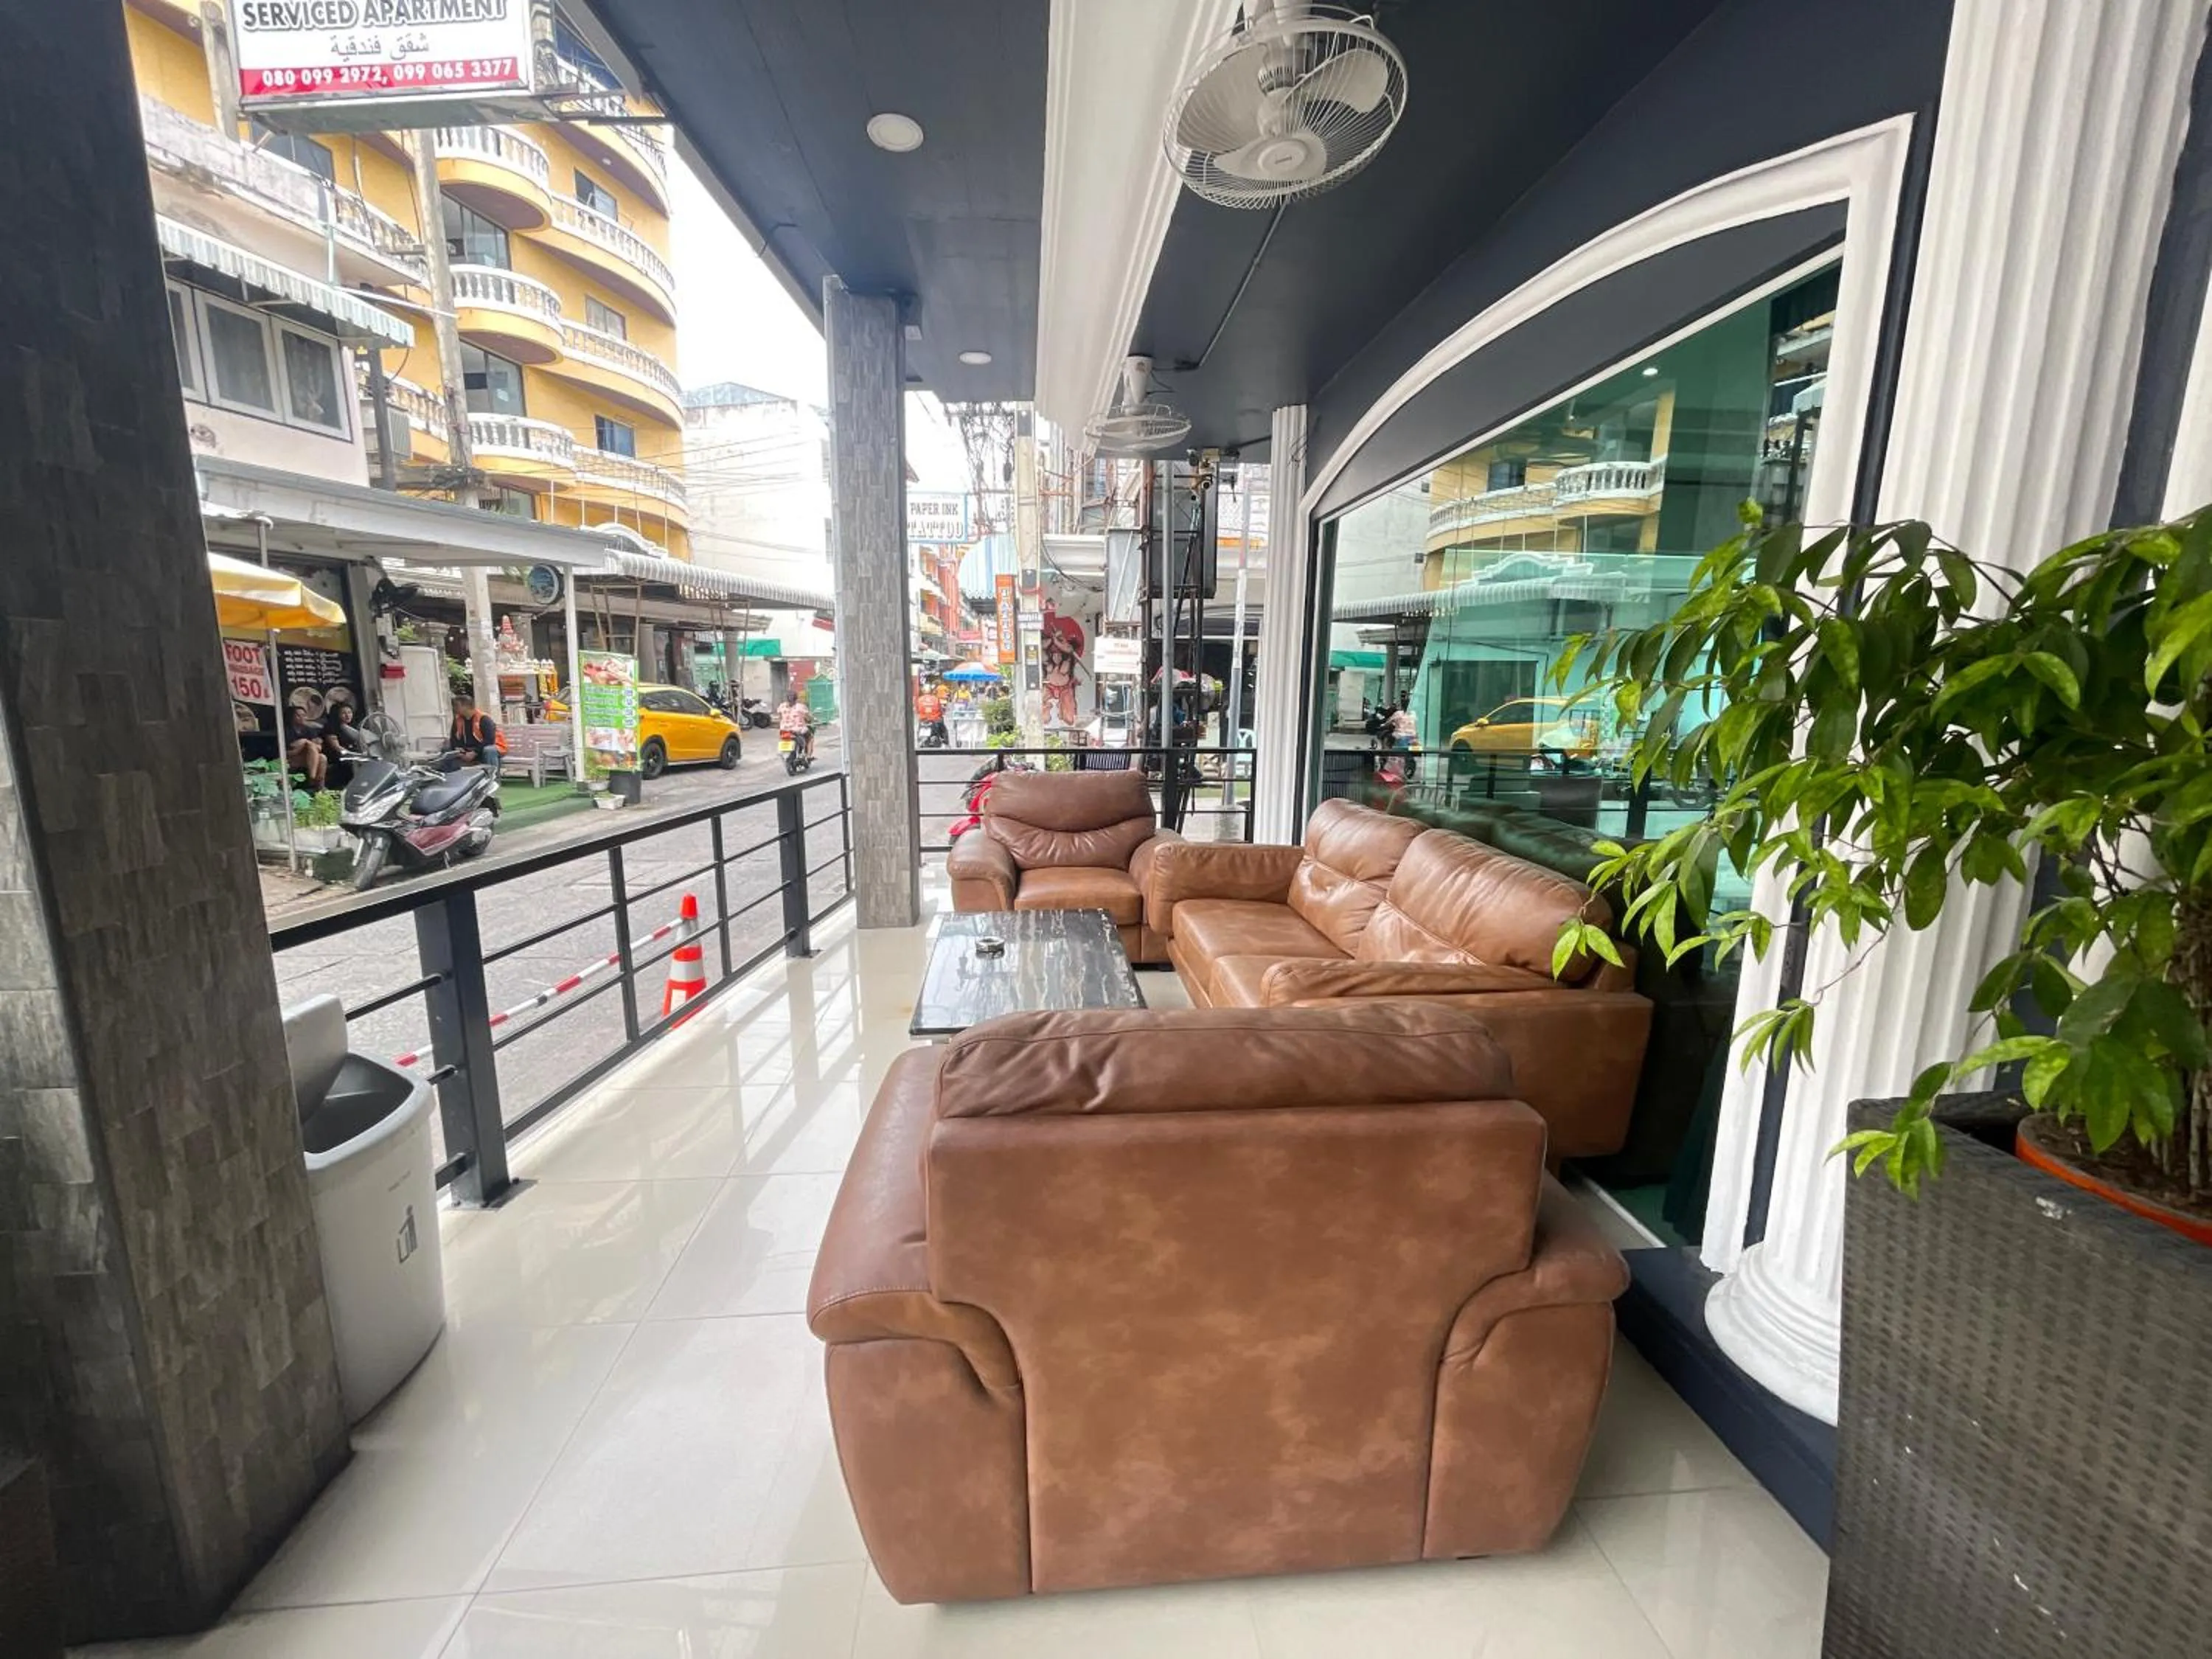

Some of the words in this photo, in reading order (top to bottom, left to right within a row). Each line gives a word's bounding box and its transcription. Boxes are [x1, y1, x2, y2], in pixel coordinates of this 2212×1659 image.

[242, 0, 355, 27] SERVICED
[363, 0, 505, 24] APARTMENT
[330, 35, 382, 63] فندقية
[389, 32, 430, 60] شقق
[262, 69, 296, 87] 080
[301, 68, 333, 86] 099
[340, 66, 389, 85] 2972,
[392, 64, 426, 81] 099
[431, 62, 464, 80] 065
[470, 58, 513, 77] 3377
[909, 502, 939, 515] PAPER
[942, 502, 959, 515] INK
[224, 643, 260, 664] FOOT
